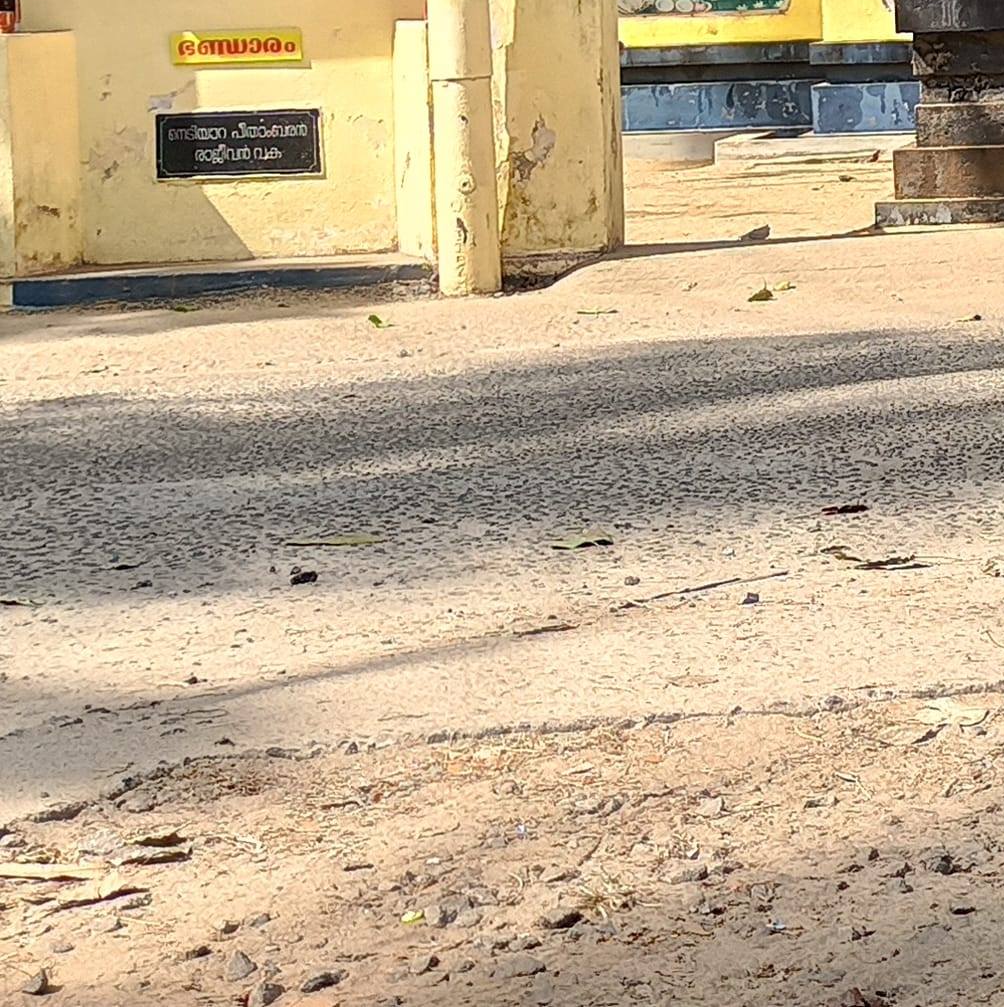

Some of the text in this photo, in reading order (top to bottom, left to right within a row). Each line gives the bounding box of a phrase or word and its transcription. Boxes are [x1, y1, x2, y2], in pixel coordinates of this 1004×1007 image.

[177, 37, 296, 56] ഭണ്ഡാരം
[194, 143, 283, 164] രാജീവൻ വക
